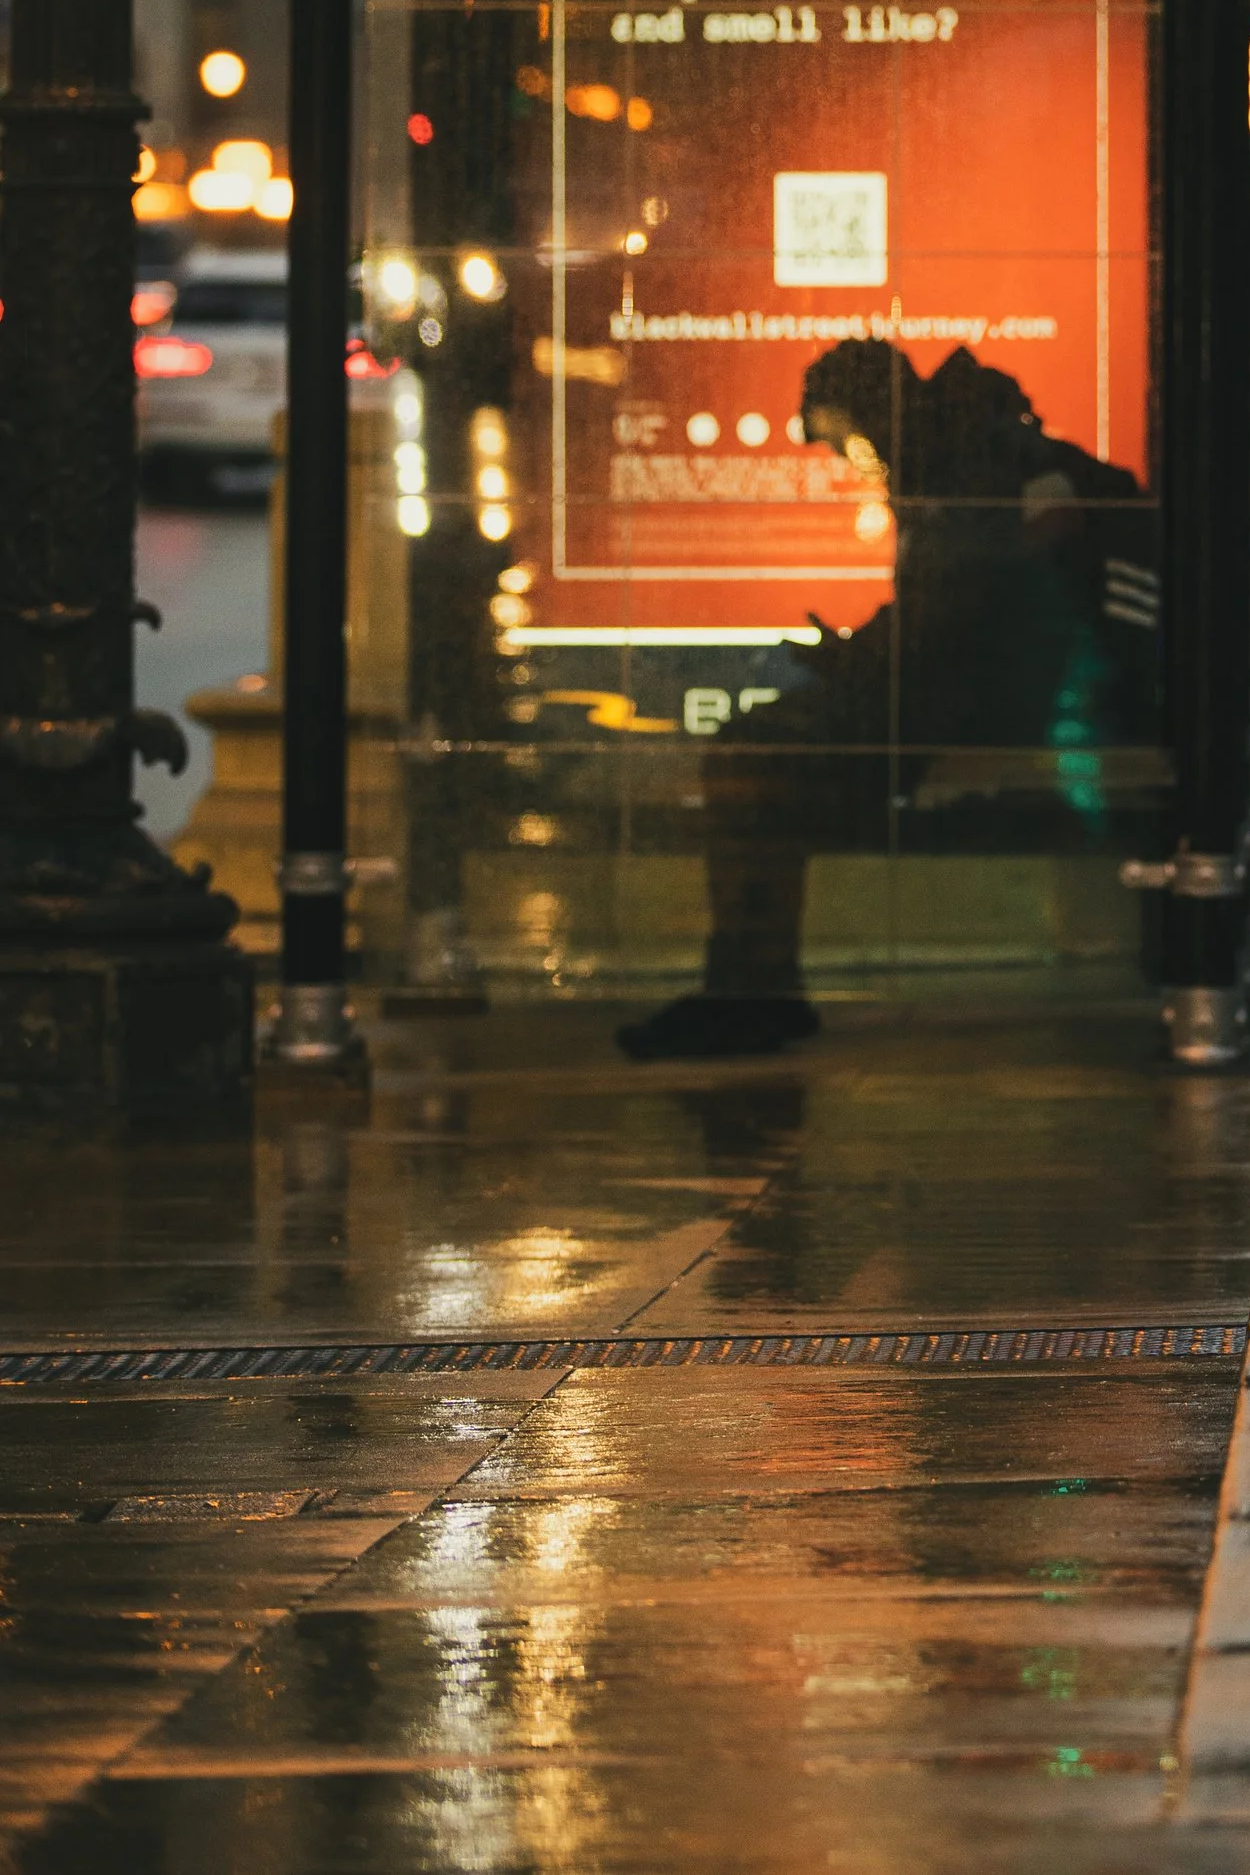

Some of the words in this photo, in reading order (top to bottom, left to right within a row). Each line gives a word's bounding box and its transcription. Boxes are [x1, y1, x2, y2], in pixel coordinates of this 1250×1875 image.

[610, 6, 685, 43] and
[702, 5, 821, 43] smell
[840, 4, 959, 43] like?
